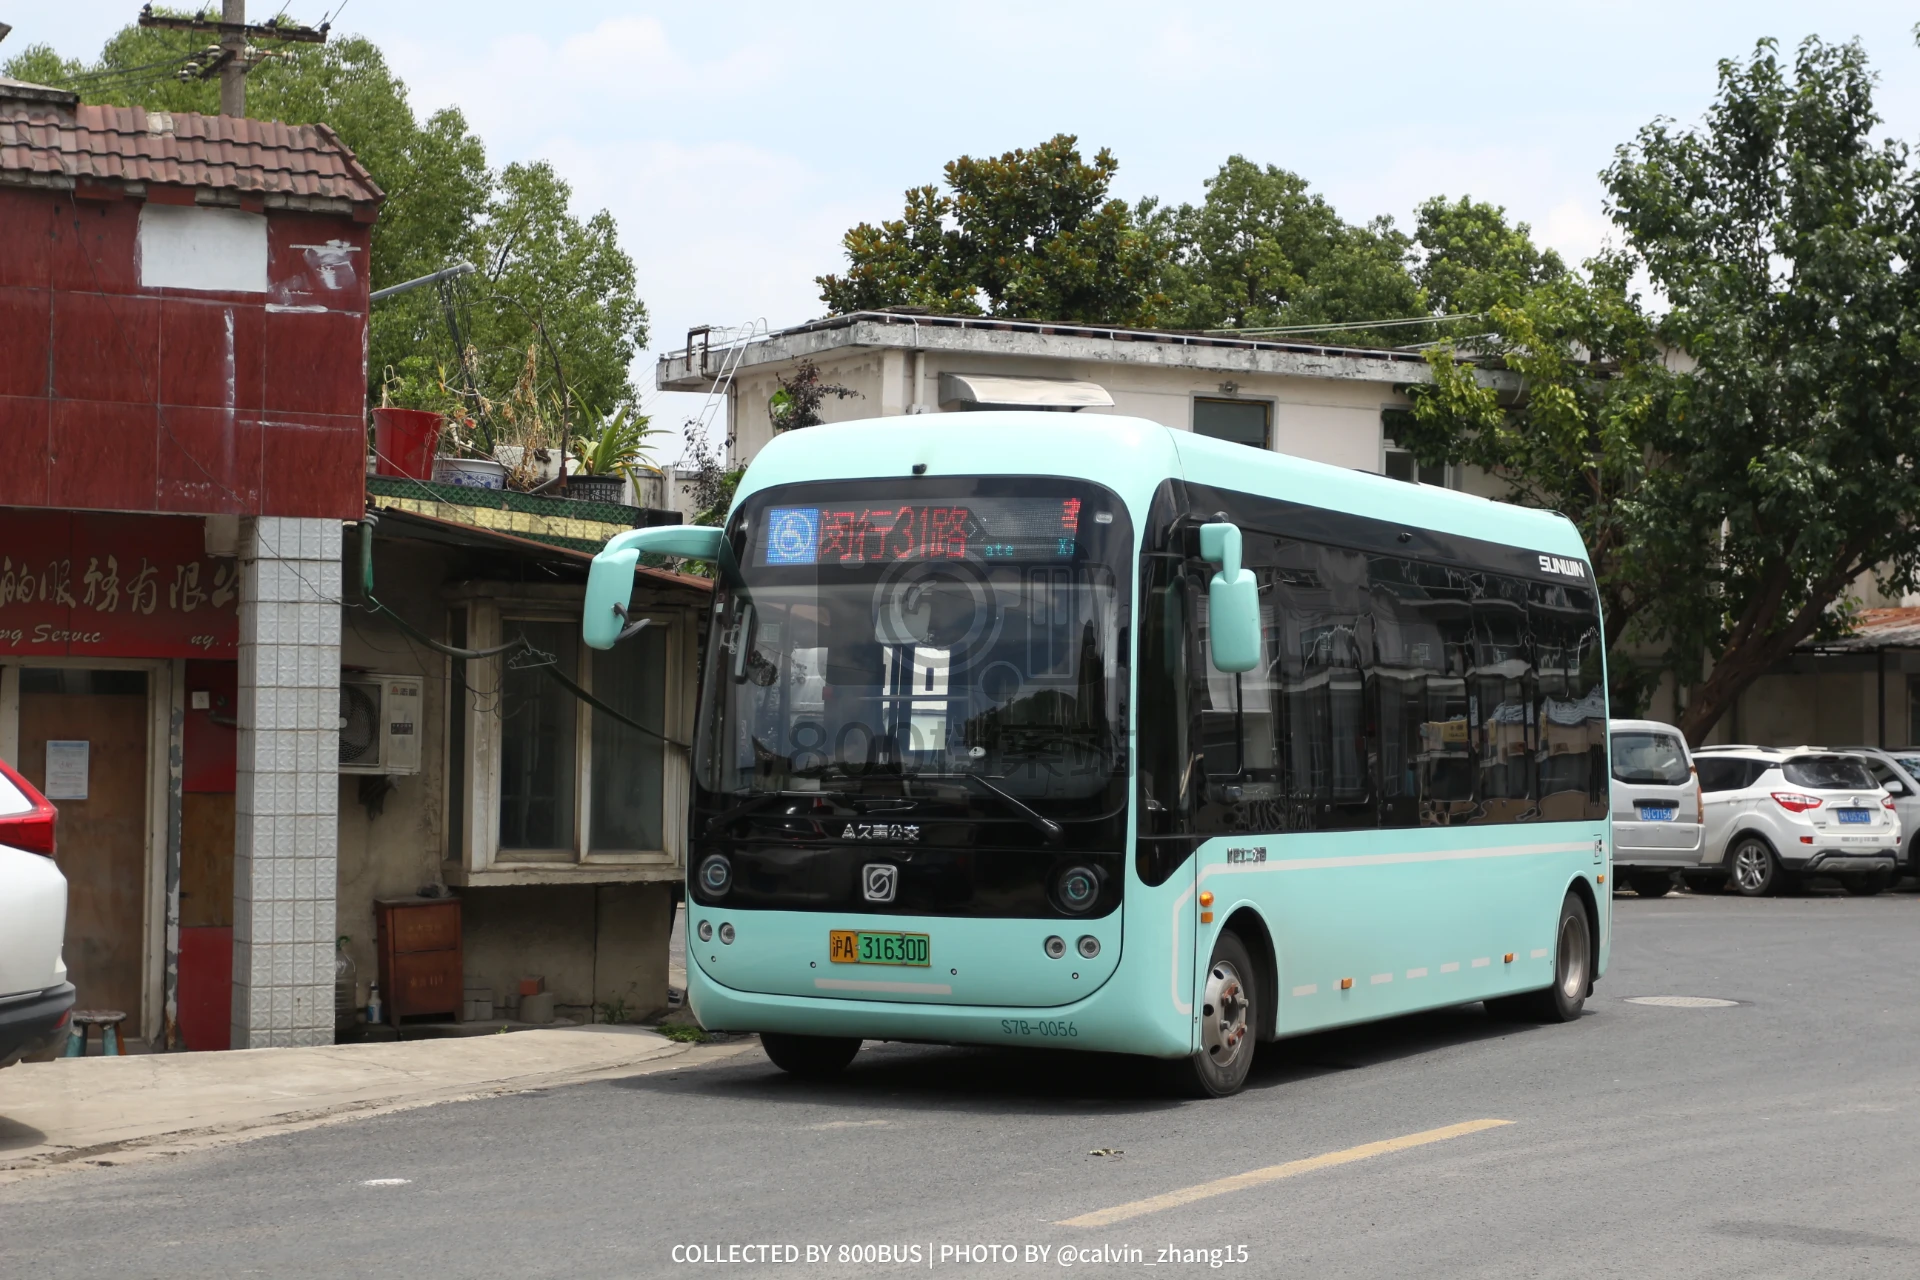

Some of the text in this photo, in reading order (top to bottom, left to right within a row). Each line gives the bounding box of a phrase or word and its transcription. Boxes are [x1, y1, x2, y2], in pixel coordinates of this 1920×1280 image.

[819, 506, 968, 560] 闵行31路
[1538, 555, 1585, 578] SUNWIN
[857, 823, 919, 841] 久事公交
[832, 935, 927, 962] 沪A31630D
[1001, 1019, 1078, 1037] S7B-0056
